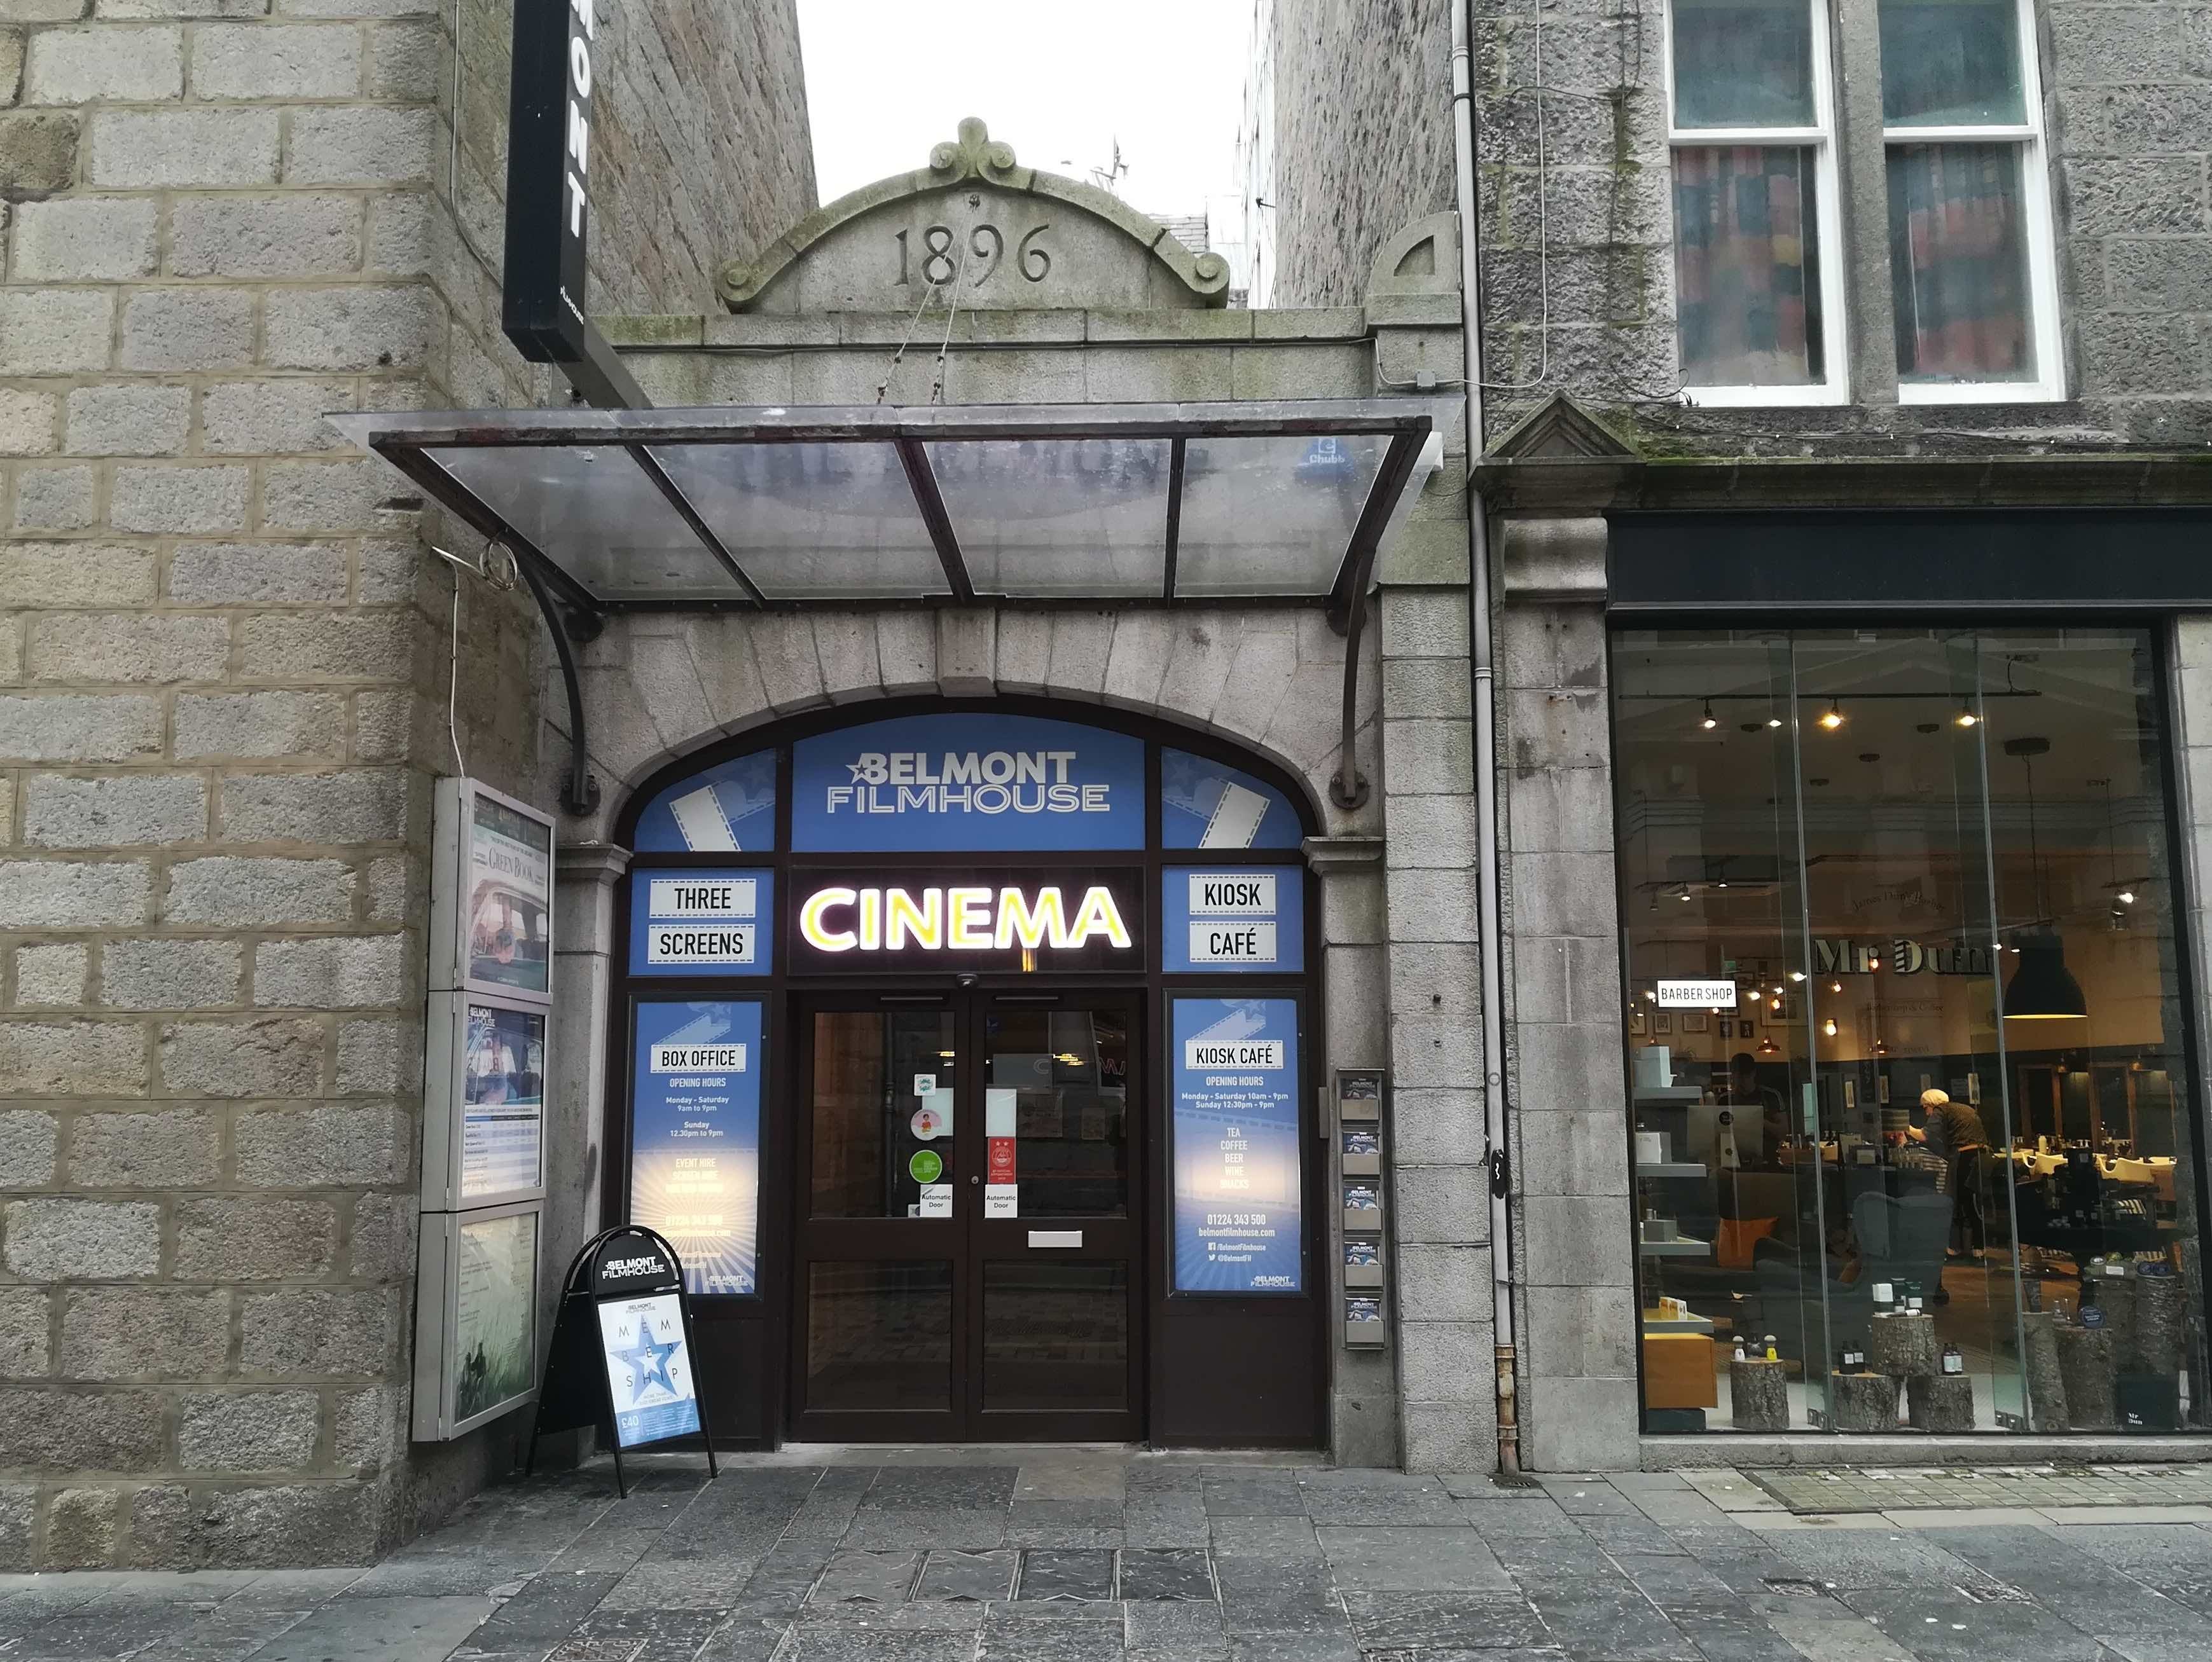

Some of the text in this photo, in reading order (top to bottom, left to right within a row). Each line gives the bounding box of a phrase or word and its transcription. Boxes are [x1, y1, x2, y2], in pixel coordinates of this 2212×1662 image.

[894, 224, 1051, 287] 1896
[1310, 454, 1346, 464] Chubb
[846, 752, 1076, 785] BELMONT
[827, 784, 1110, 814] FILMHOUSE
[488, 846, 513, 874] GREEN
[515, 856, 534, 883] BOOK
[674, 888, 731, 909] THREE
[1205, 883, 1262, 906] KIOSK
[800, 886, 1132, 952] CINEMA
[660, 933, 743, 954] SCREENS
[1210, 928, 1257, 956] CAFÉ
[1813, 939, 1993, 974] Mr Dun
[1661, 988, 1732, 999] BARBER SHOP
[662, 1050, 735, 1066] BOX OFFICE
[1197, 1045, 1273, 1063] KIOSK CAFÉ
[670, 1078, 726, 1087] OPENING HOURS
[1206, 1076, 1264, 1086] OPENING HOURS
[1227, 1128, 1240, 1137] TEA
[1220, 1140, 1247, 1150] COFFEE
[675, 1158, 698, 1168] EVENT
[1225, 1153, 1243, 1163] BEER
[1225, 1166, 1244, 1176] WINE
[1207, 1214, 1266, 1225] 01224 343 500
[1198, 1227, 1275, 1237] belmontfilmhouse.com
[605, 1256, 656, 1270] BELMONT
[602, 1264, 665, 1280] FILMHOUSE
[621, 1415, 639, 1429] £40
